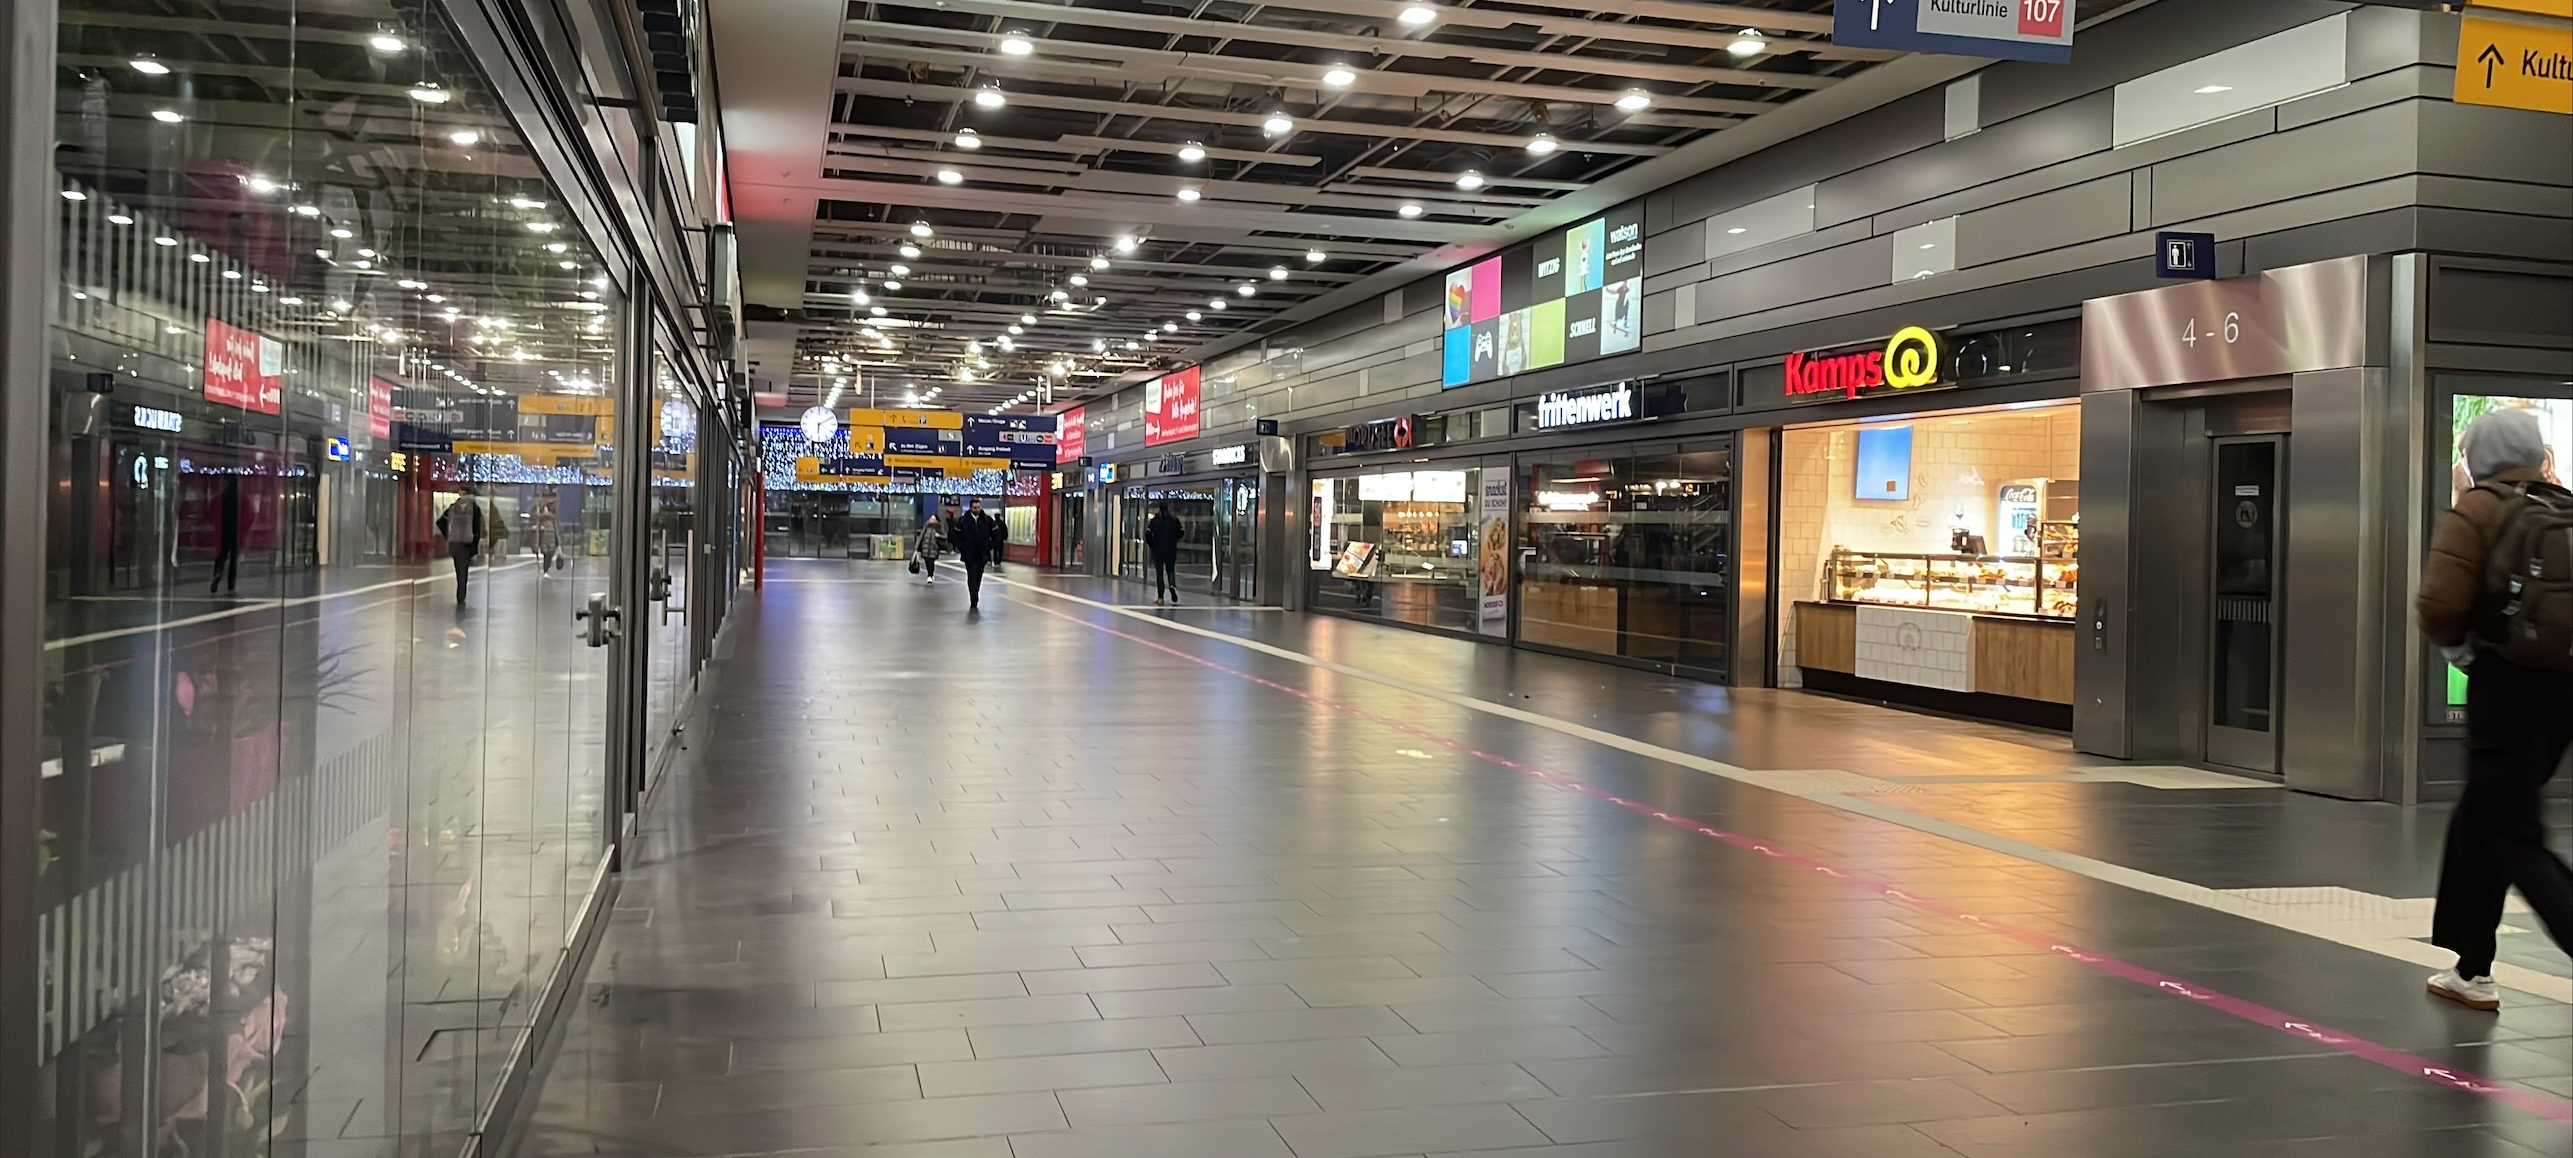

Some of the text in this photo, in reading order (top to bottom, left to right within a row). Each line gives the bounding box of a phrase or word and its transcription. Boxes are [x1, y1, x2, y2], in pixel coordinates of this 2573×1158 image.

[1930, 0, 2060, 23] Kulturlinie 107
[1610, 222, 1638, 244] watson
[2182, 318, 2197, 348] 4
[2224, 312, 2239, 343] 6
[1785, 351, 1883, 400] Kamps
[1537, 381, 1632, 429] frittenwerk
